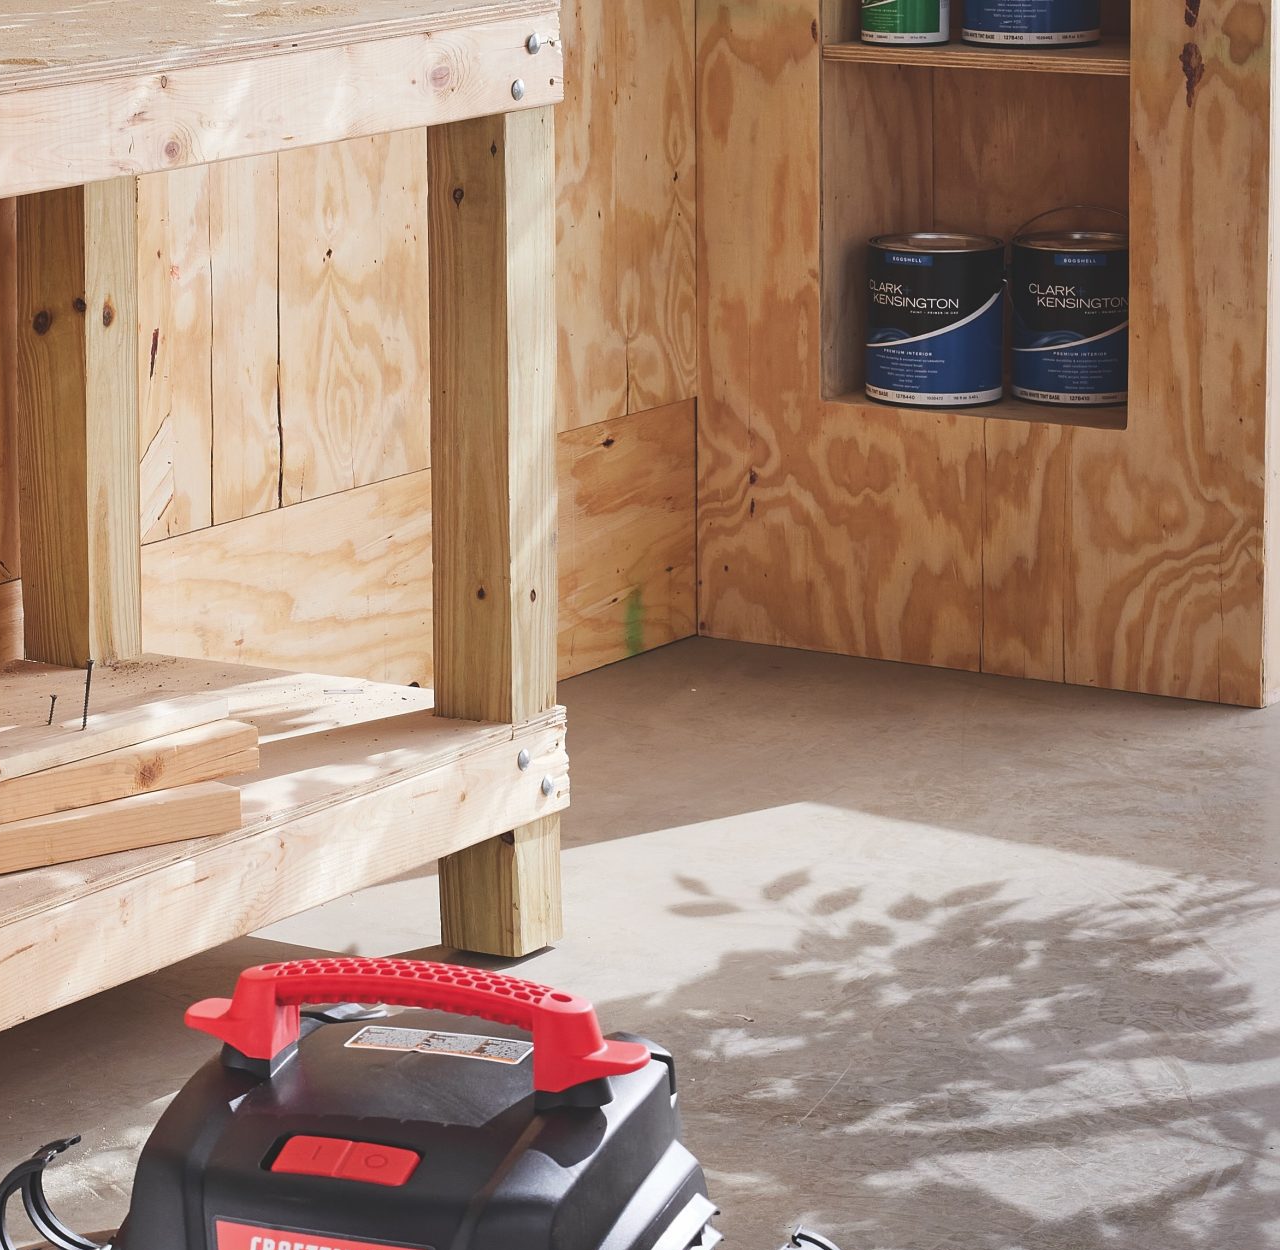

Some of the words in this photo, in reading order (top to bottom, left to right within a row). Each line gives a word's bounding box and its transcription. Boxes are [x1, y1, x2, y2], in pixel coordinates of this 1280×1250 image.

[870, 279, 903, 295] CLARK
[1028, 283, 1076, 296] CLARK
[873, 294, 959, 309] KENSINGTON
[1037, 296, 1128, 309] KENSINGTON
